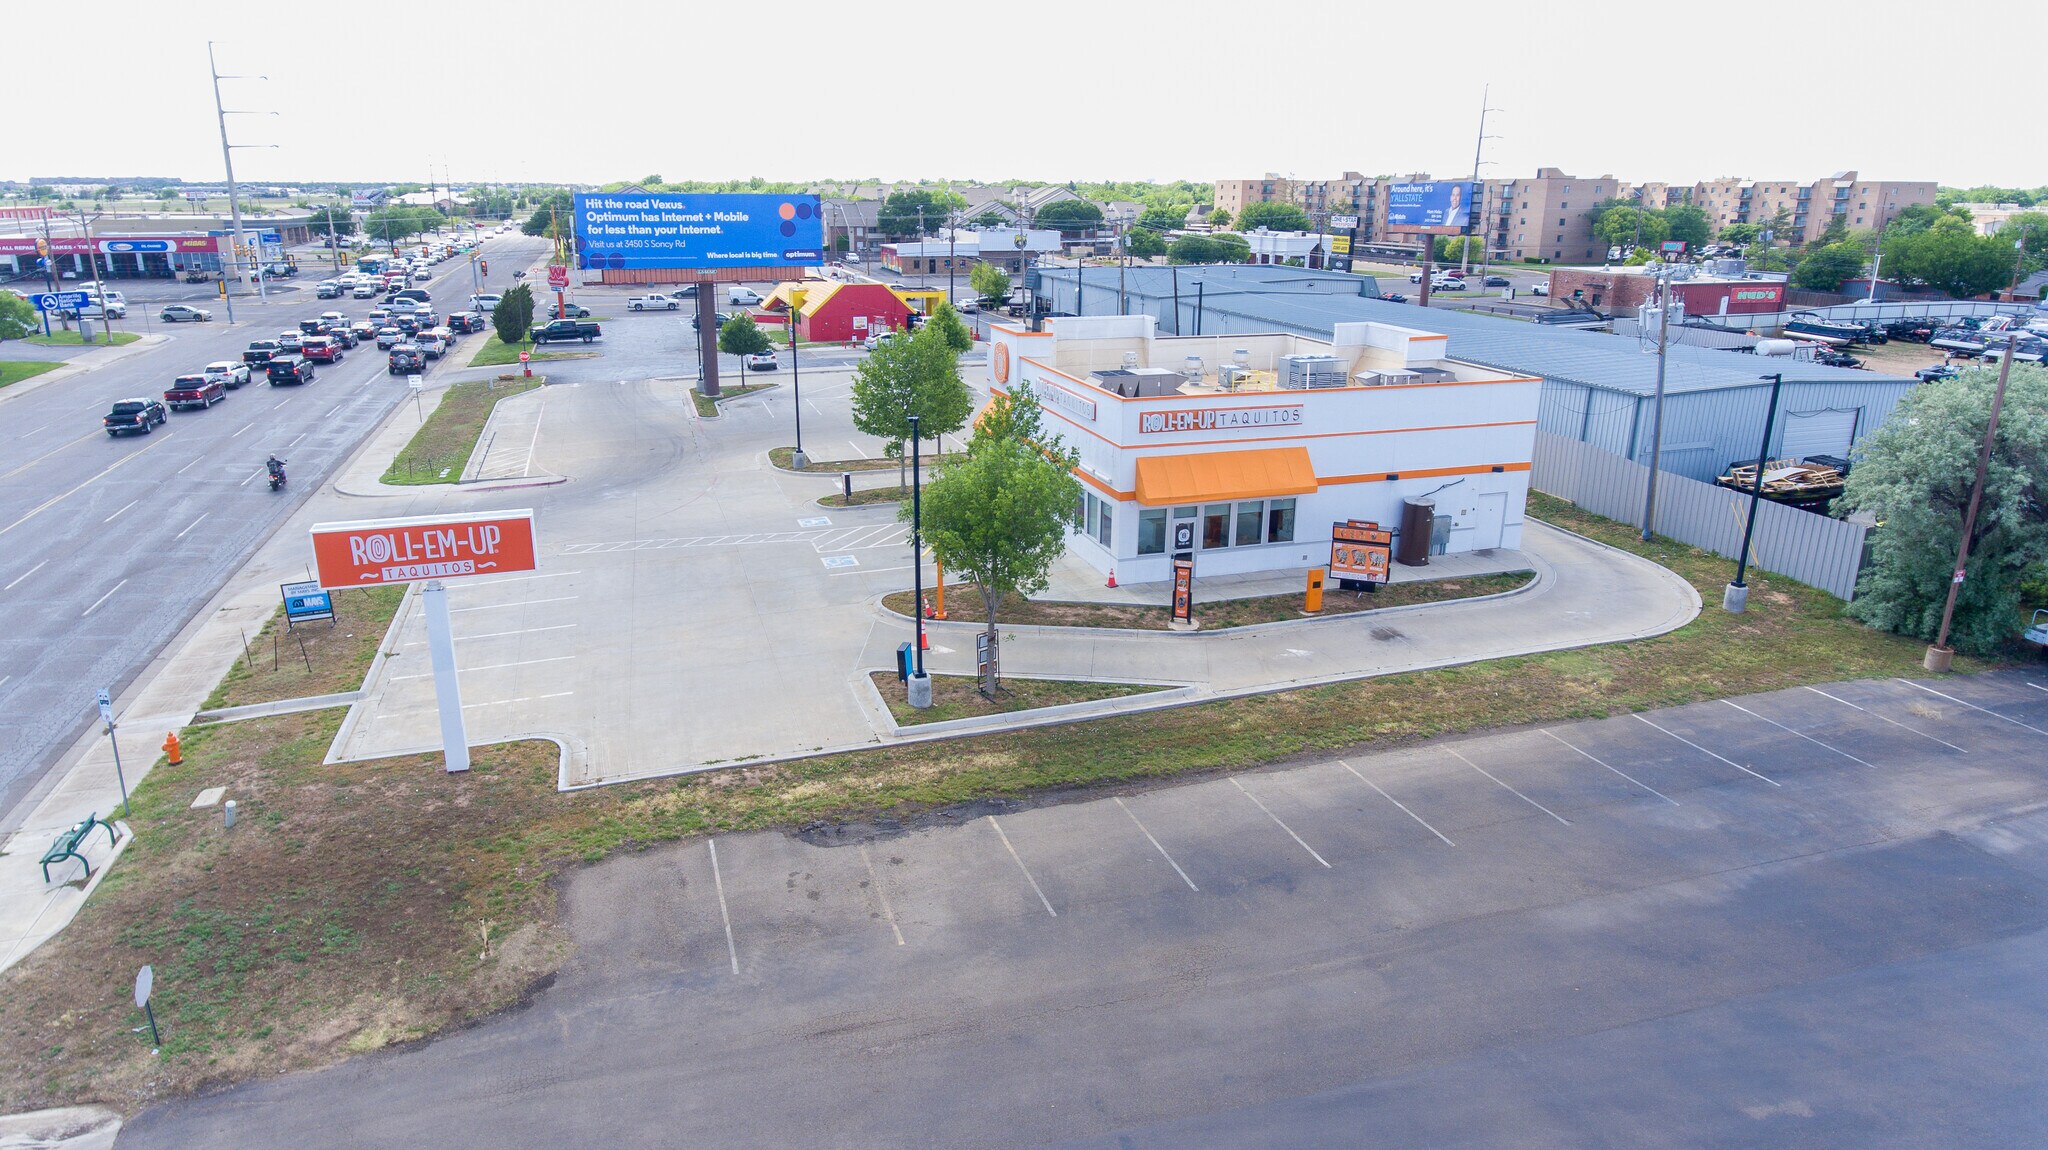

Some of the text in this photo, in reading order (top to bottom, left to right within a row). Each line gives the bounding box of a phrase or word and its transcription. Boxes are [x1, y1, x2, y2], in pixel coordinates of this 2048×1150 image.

[1390, 184, 1410, 192] Around
[1411, 184, 1424, 193] here,
[585, 199, 685, 209] Hit the road Vexus.
[586, 211, 639, 223] Optimum
[641, 211, 659, 221] has
[662, 212, 703, 221] Internet
[714, 211, 749, 222] Mobile
[587, 224, 723, 236] for less than your Internet.
[588, 240, 605, 248] Visit
[616, 240, 623, 248] at
[624, 240, 642, 248] 3450
[644, 240, 649, 248] S
[651, 240, 673, 249] Soncy
[675, 240, 686, 248] Rd
[1220, 409, 1300, 426] TAQUITOS
[385, 561, 473, 579] TAQUITOS
[303, 596, 324, 607] MAYS
